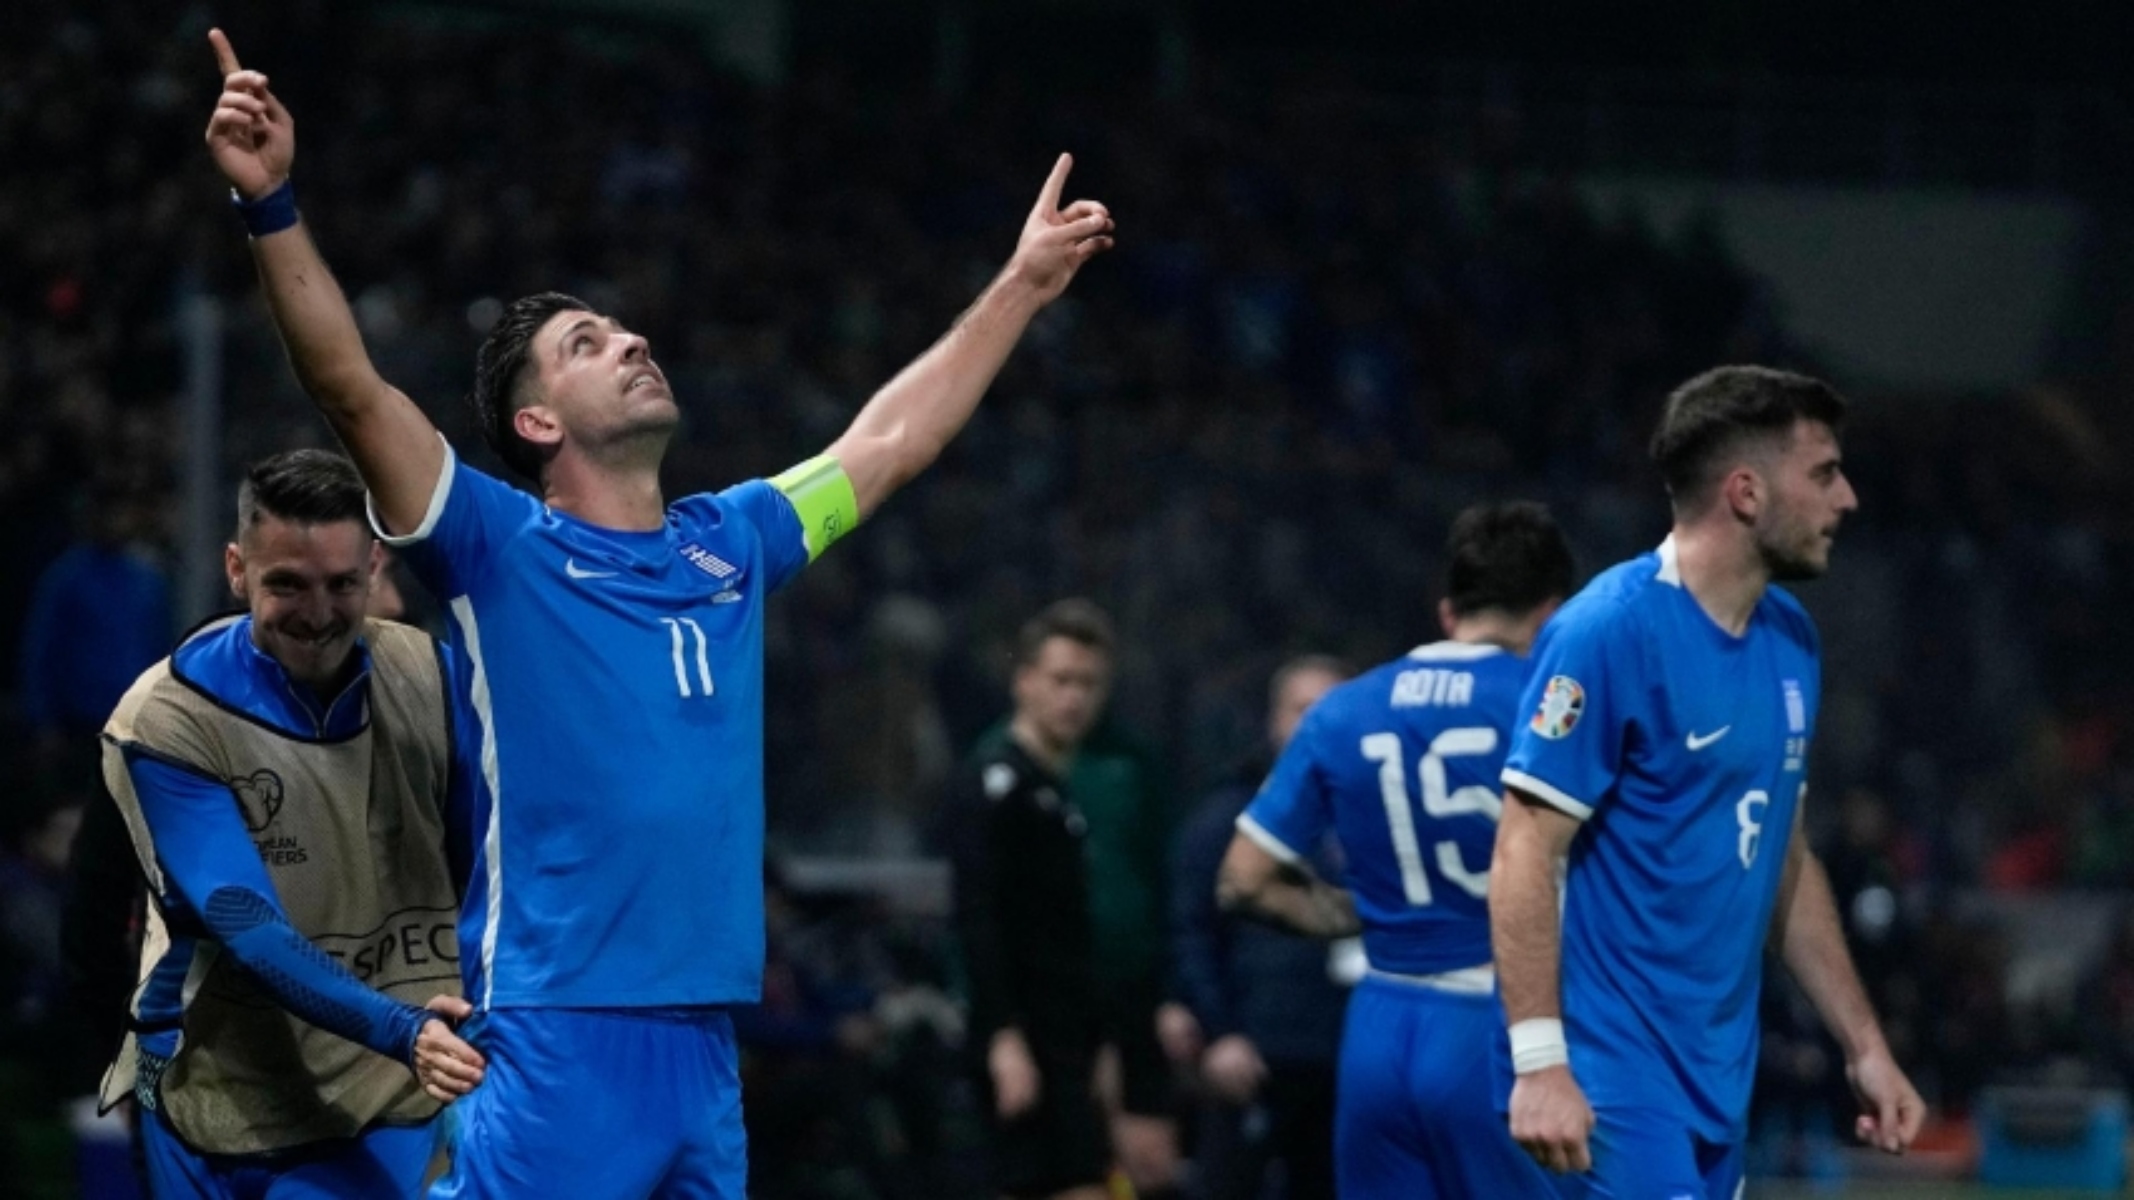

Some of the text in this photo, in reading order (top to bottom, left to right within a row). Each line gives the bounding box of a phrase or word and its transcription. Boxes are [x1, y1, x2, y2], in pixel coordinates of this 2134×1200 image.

[658, 616, 714, 697] 11
[1360, 726, 1503, 906] 15
[327, 923, 460, 982] SPEC
